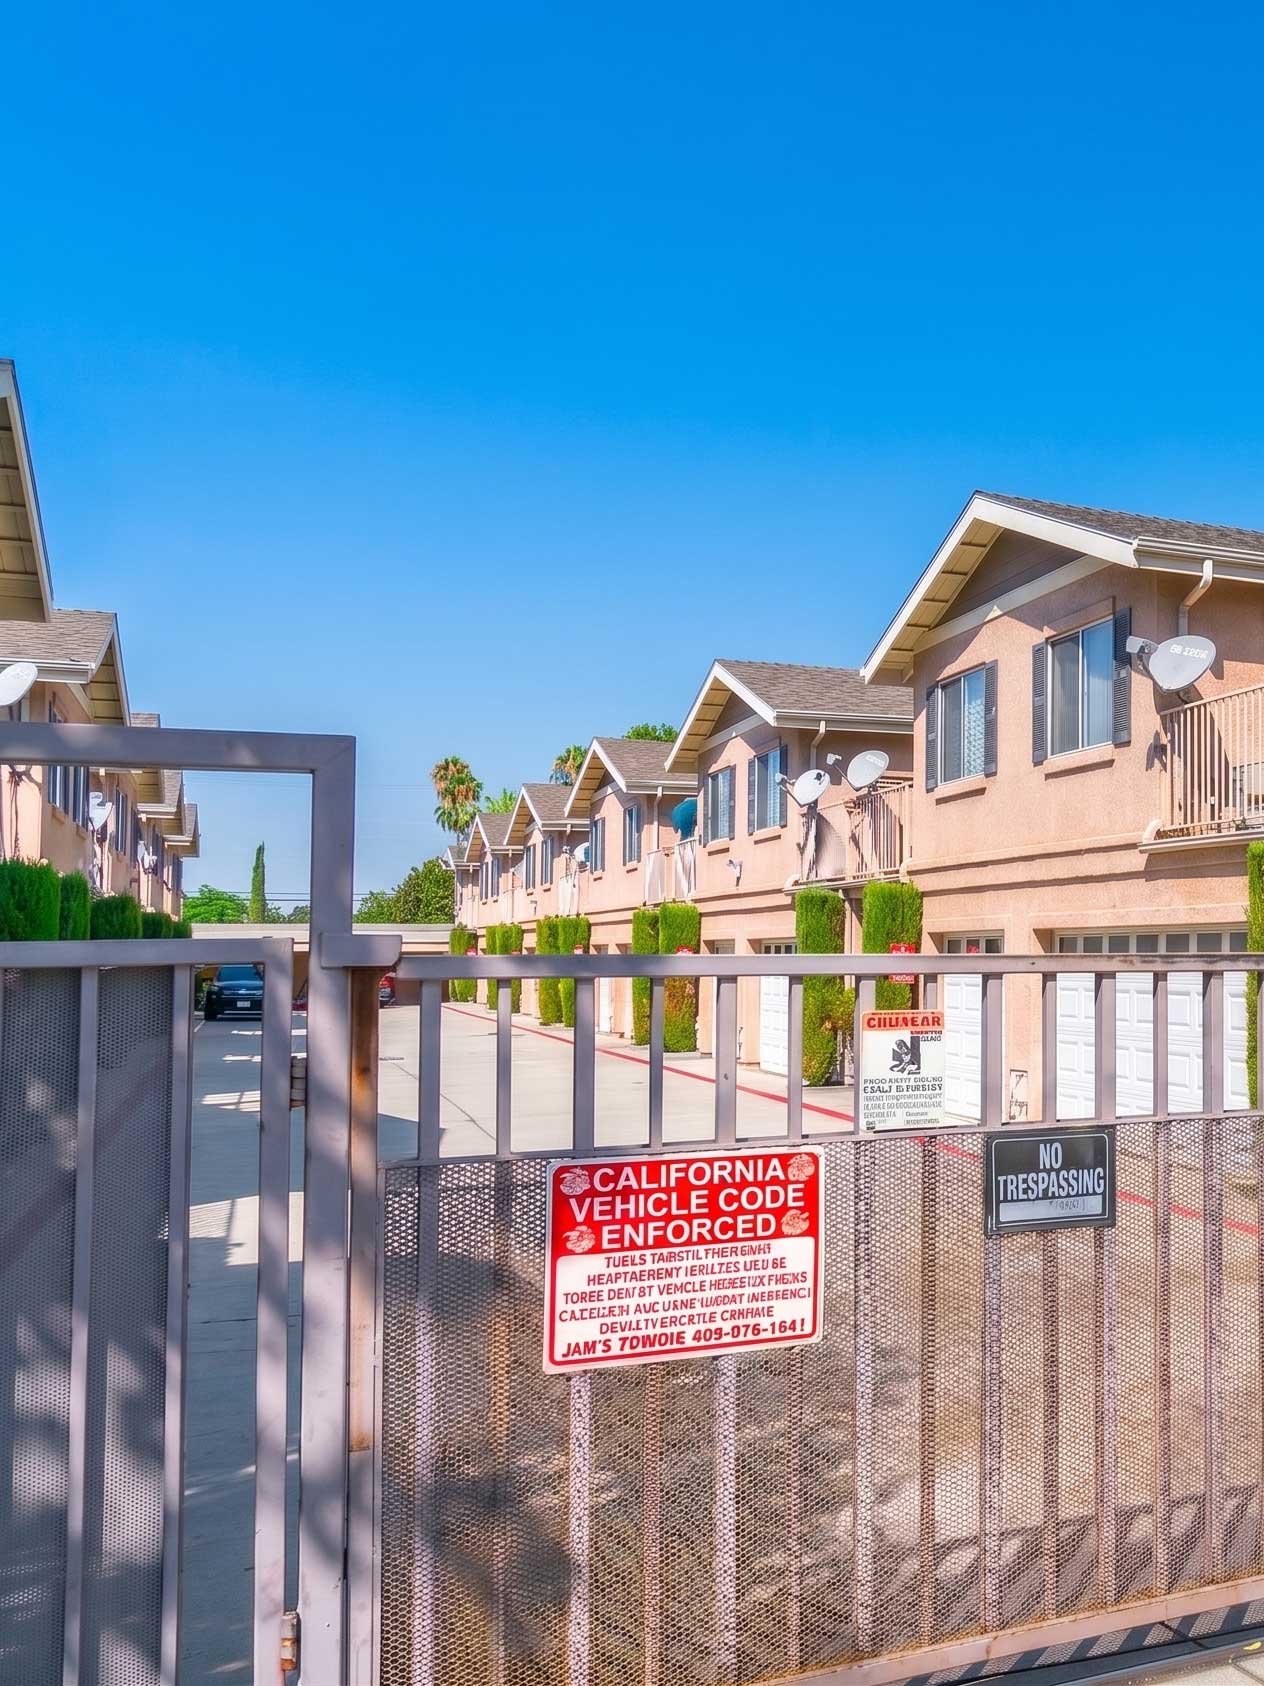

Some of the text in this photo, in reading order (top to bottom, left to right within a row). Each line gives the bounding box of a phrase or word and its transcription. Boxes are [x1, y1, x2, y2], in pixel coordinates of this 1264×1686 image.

[1039, 1142, 1063, 1170] NO
[593, 1158, 786, 1192] CALIFORNIA
[997, 1167, 1105, 1201] TRESPASSING
[569, 1184, 805, 1223] VEHICLE CODE
[601, 1213, 777, 1250] ENFORCED
